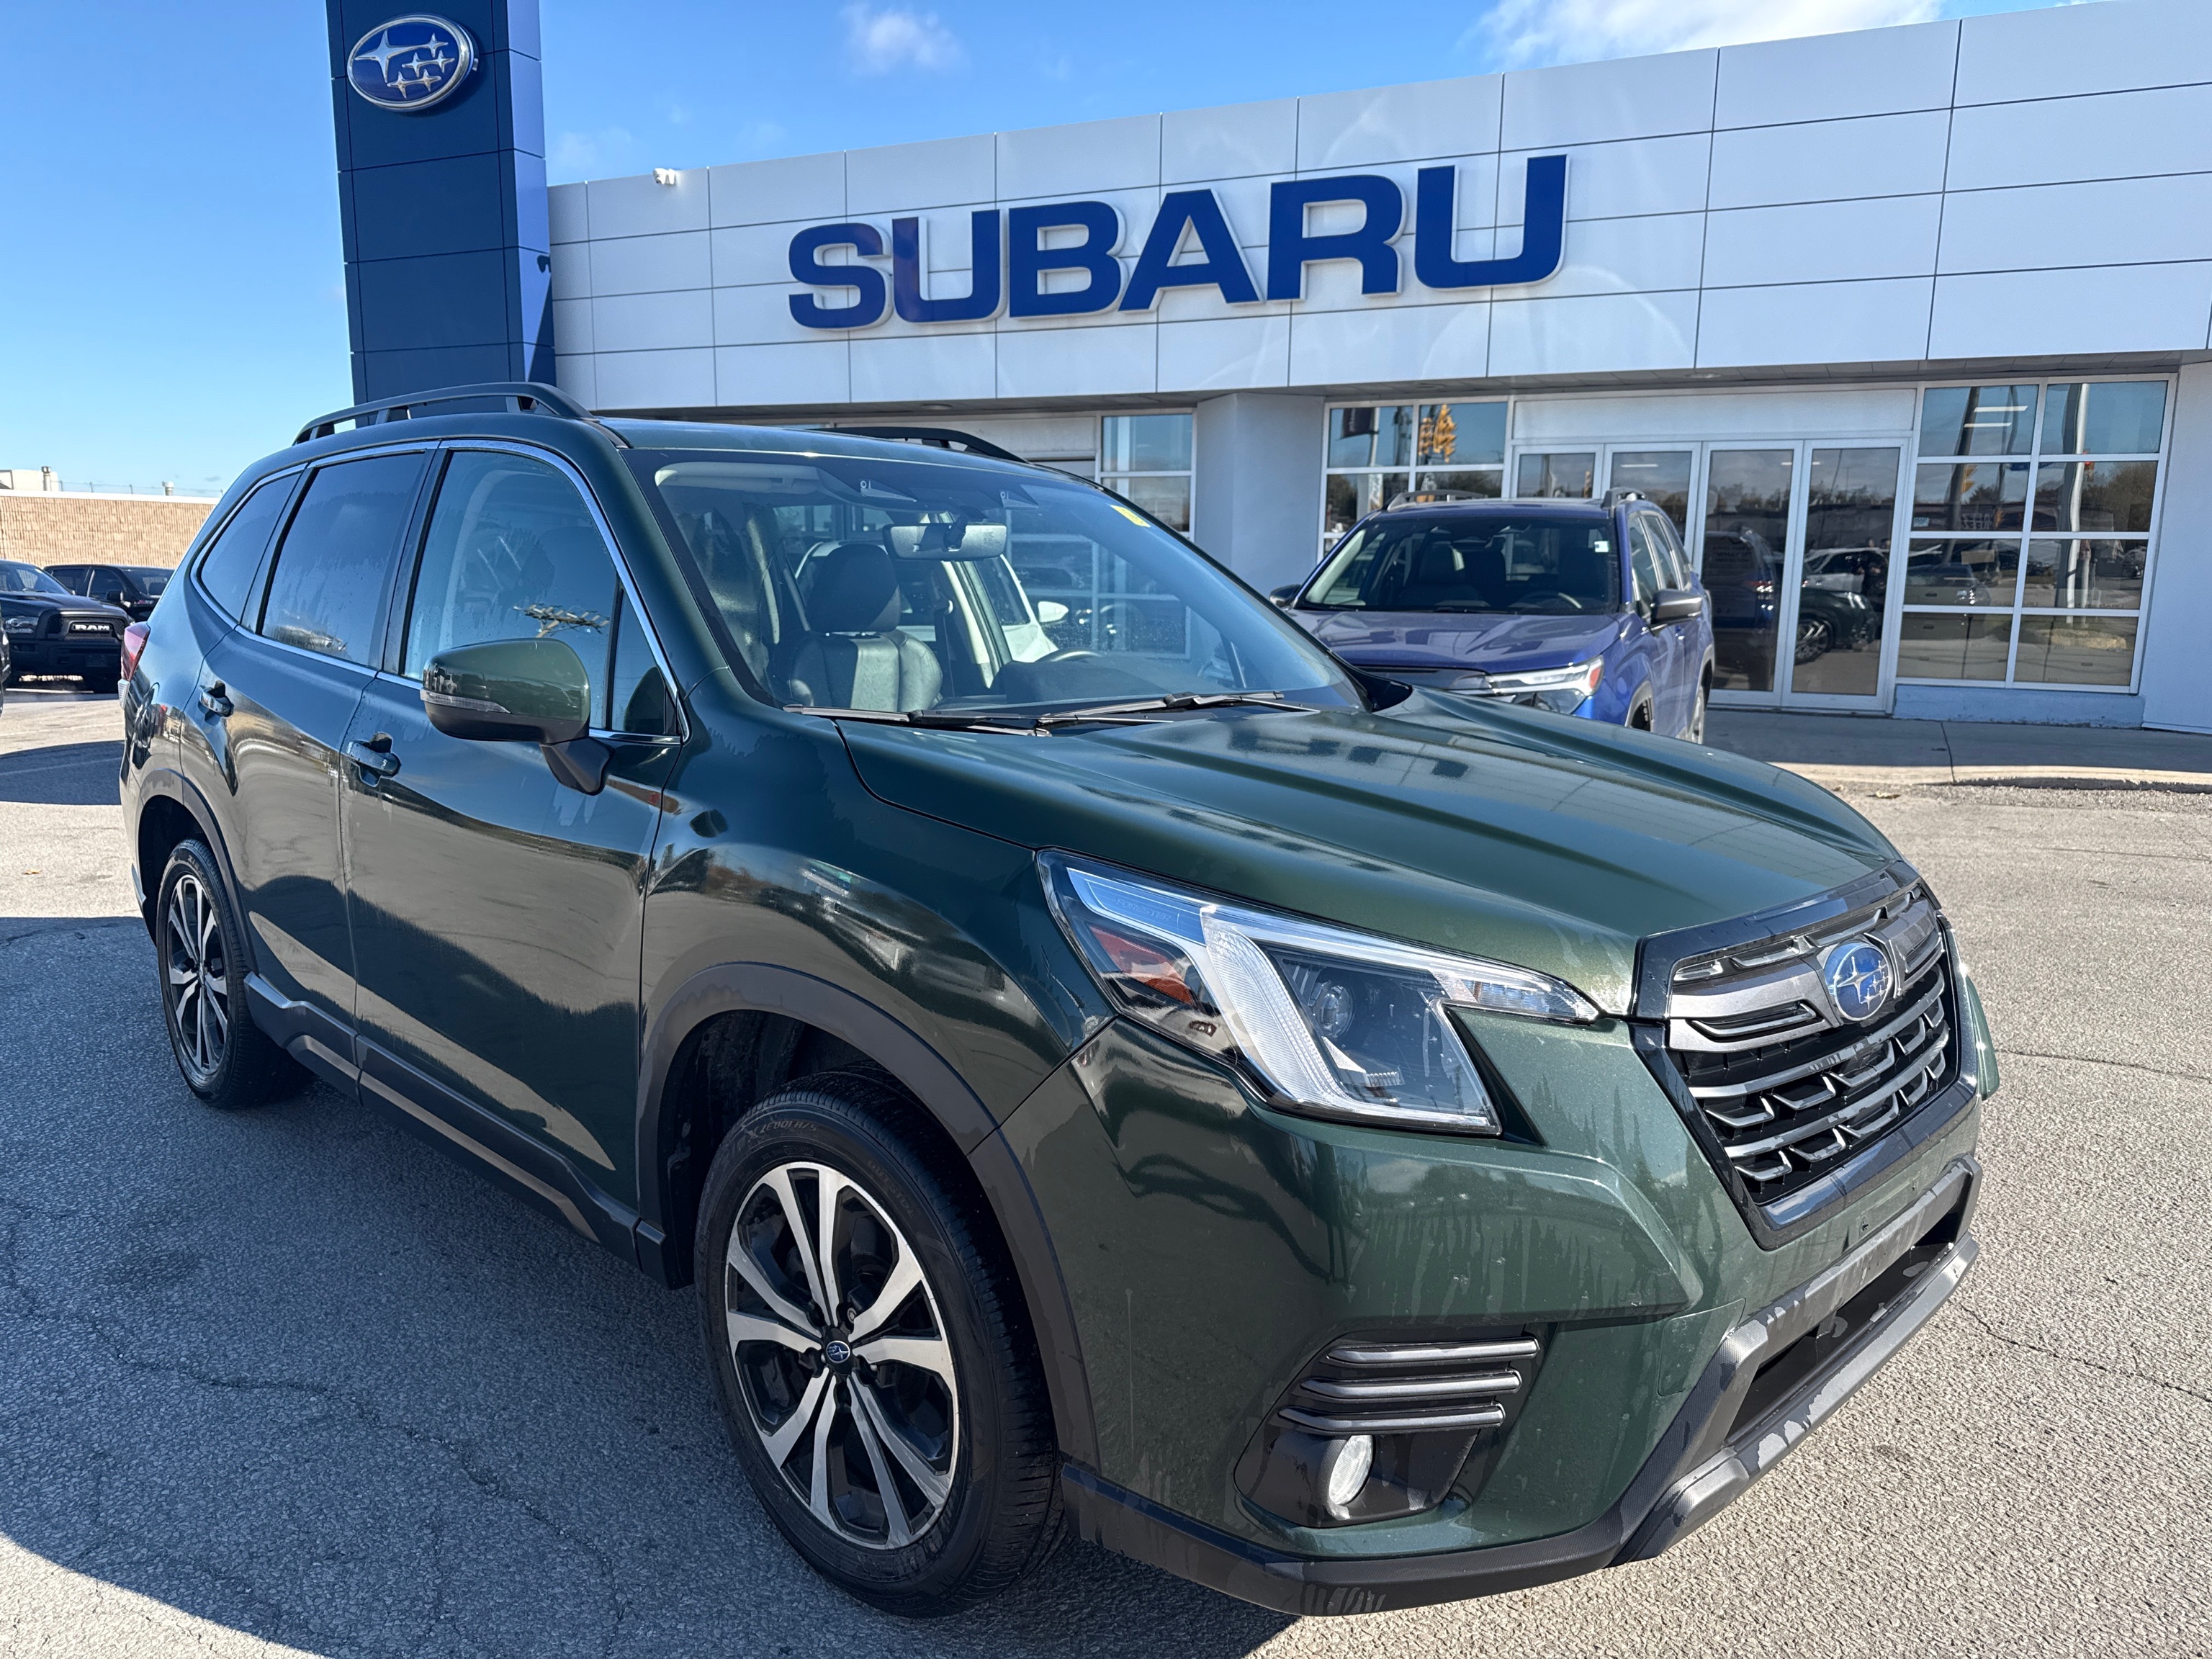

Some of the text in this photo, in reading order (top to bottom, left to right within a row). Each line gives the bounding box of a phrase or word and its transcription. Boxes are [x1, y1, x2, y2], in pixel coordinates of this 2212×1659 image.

[788, 154, 1568, 331] SUBARU
[1116, 899, 1172, 920] FORESTER
[868, 1159, 918, 1218] OUTSIDE
